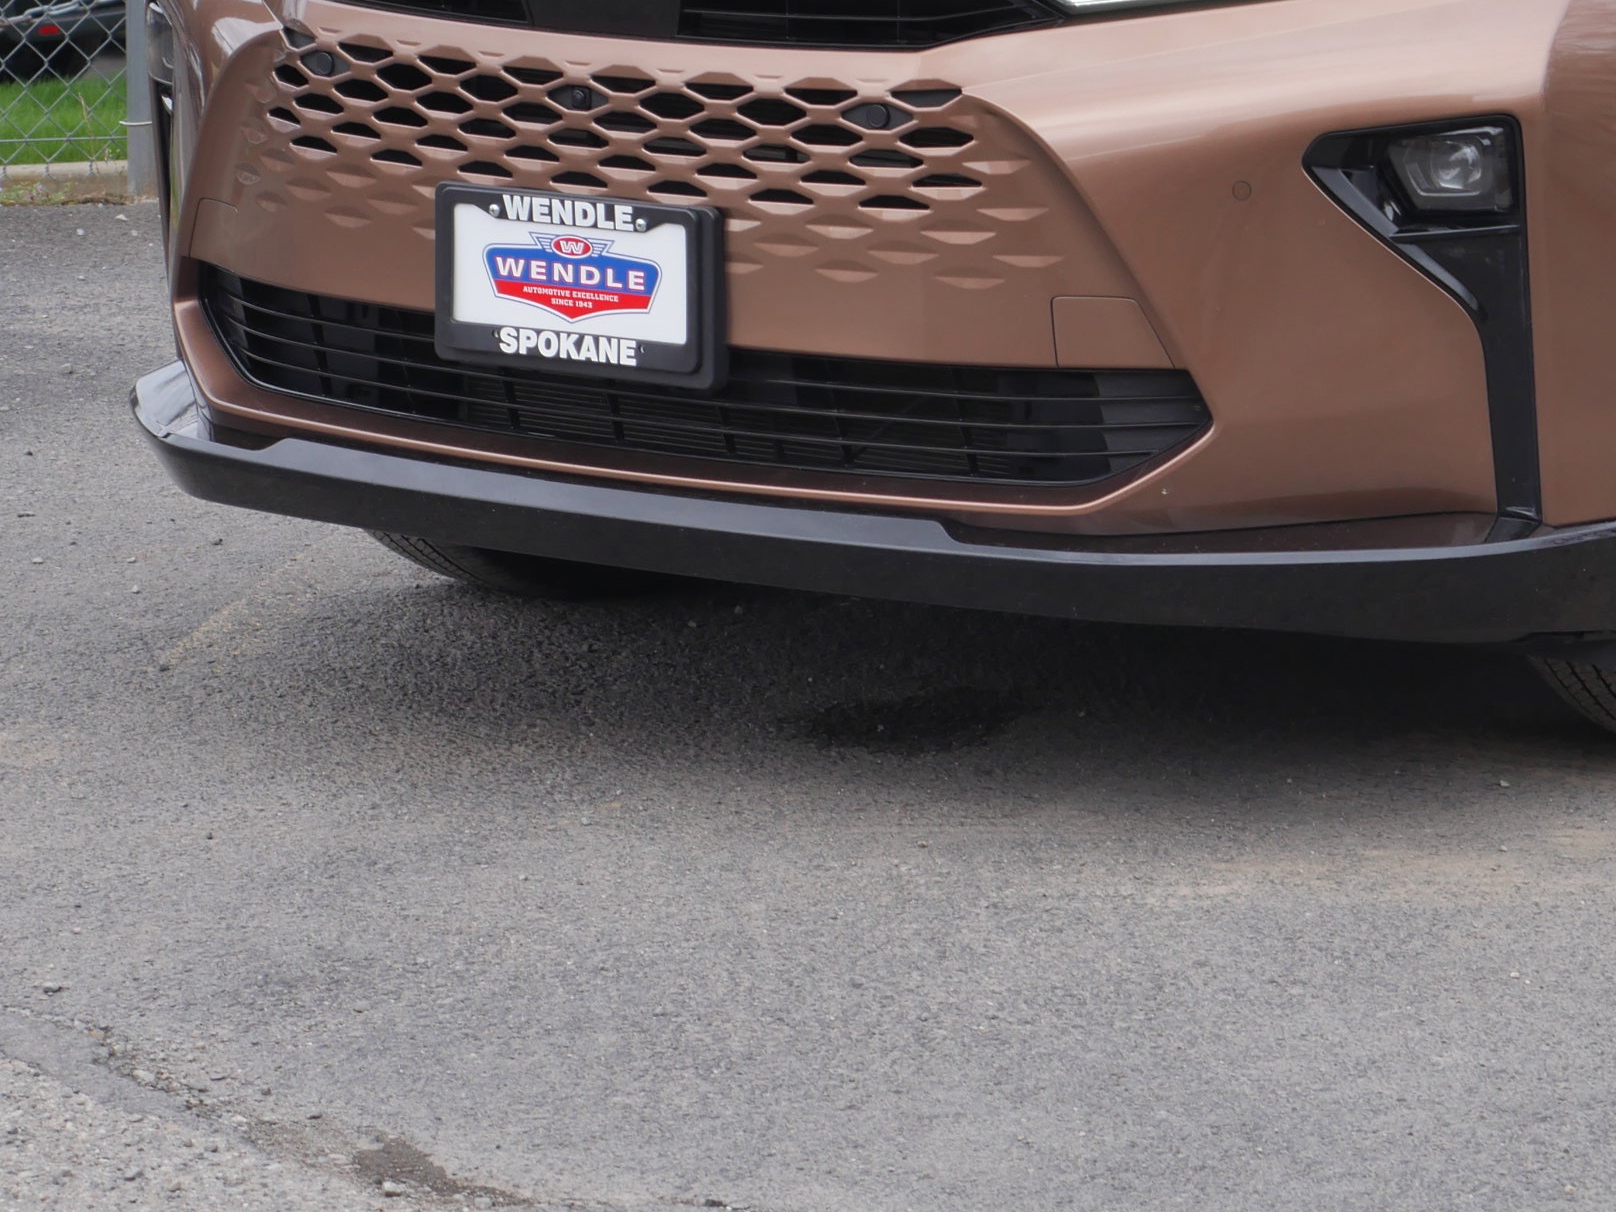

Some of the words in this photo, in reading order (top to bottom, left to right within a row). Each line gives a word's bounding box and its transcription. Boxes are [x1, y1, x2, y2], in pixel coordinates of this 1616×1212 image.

[502, 194, 634, 232] WENDLE
[495, 256, 646, 291] WENDLE
[523, 286, 570, 297] AUTOMOTIVE
[572, 290, 619, 303] EXCELLENCE
[551, 298, 574, 307] SINCE
[575, 300, 593, 309] 1943
[499, 326, 637, 367] SPOKANE
